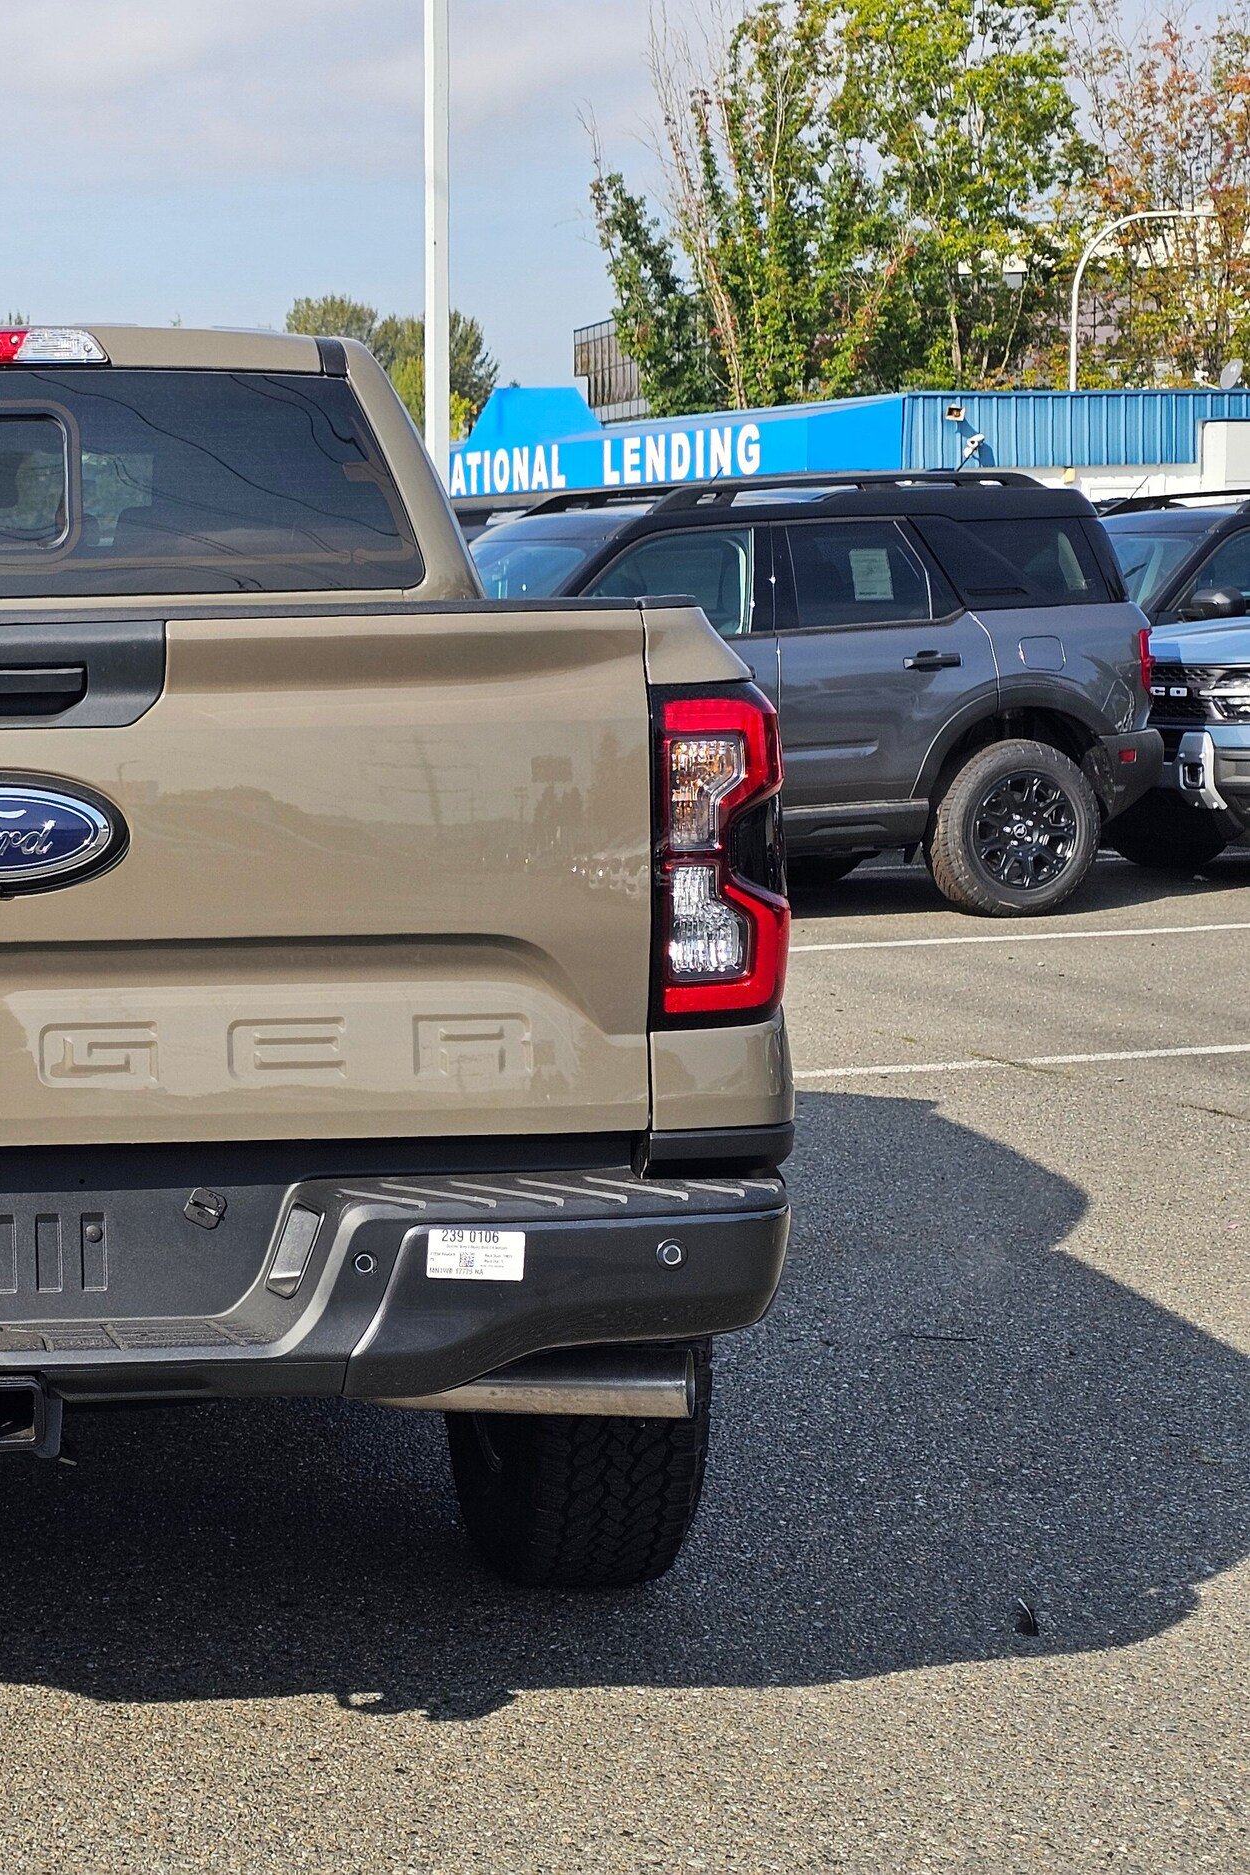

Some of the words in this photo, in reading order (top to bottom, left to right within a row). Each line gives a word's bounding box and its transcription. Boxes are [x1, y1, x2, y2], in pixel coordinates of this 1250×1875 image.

[603, 423, 761, 486] LENDING
[441, 1229, 464, 1242] 239
[469, 1230, 499, 1243] 0106
